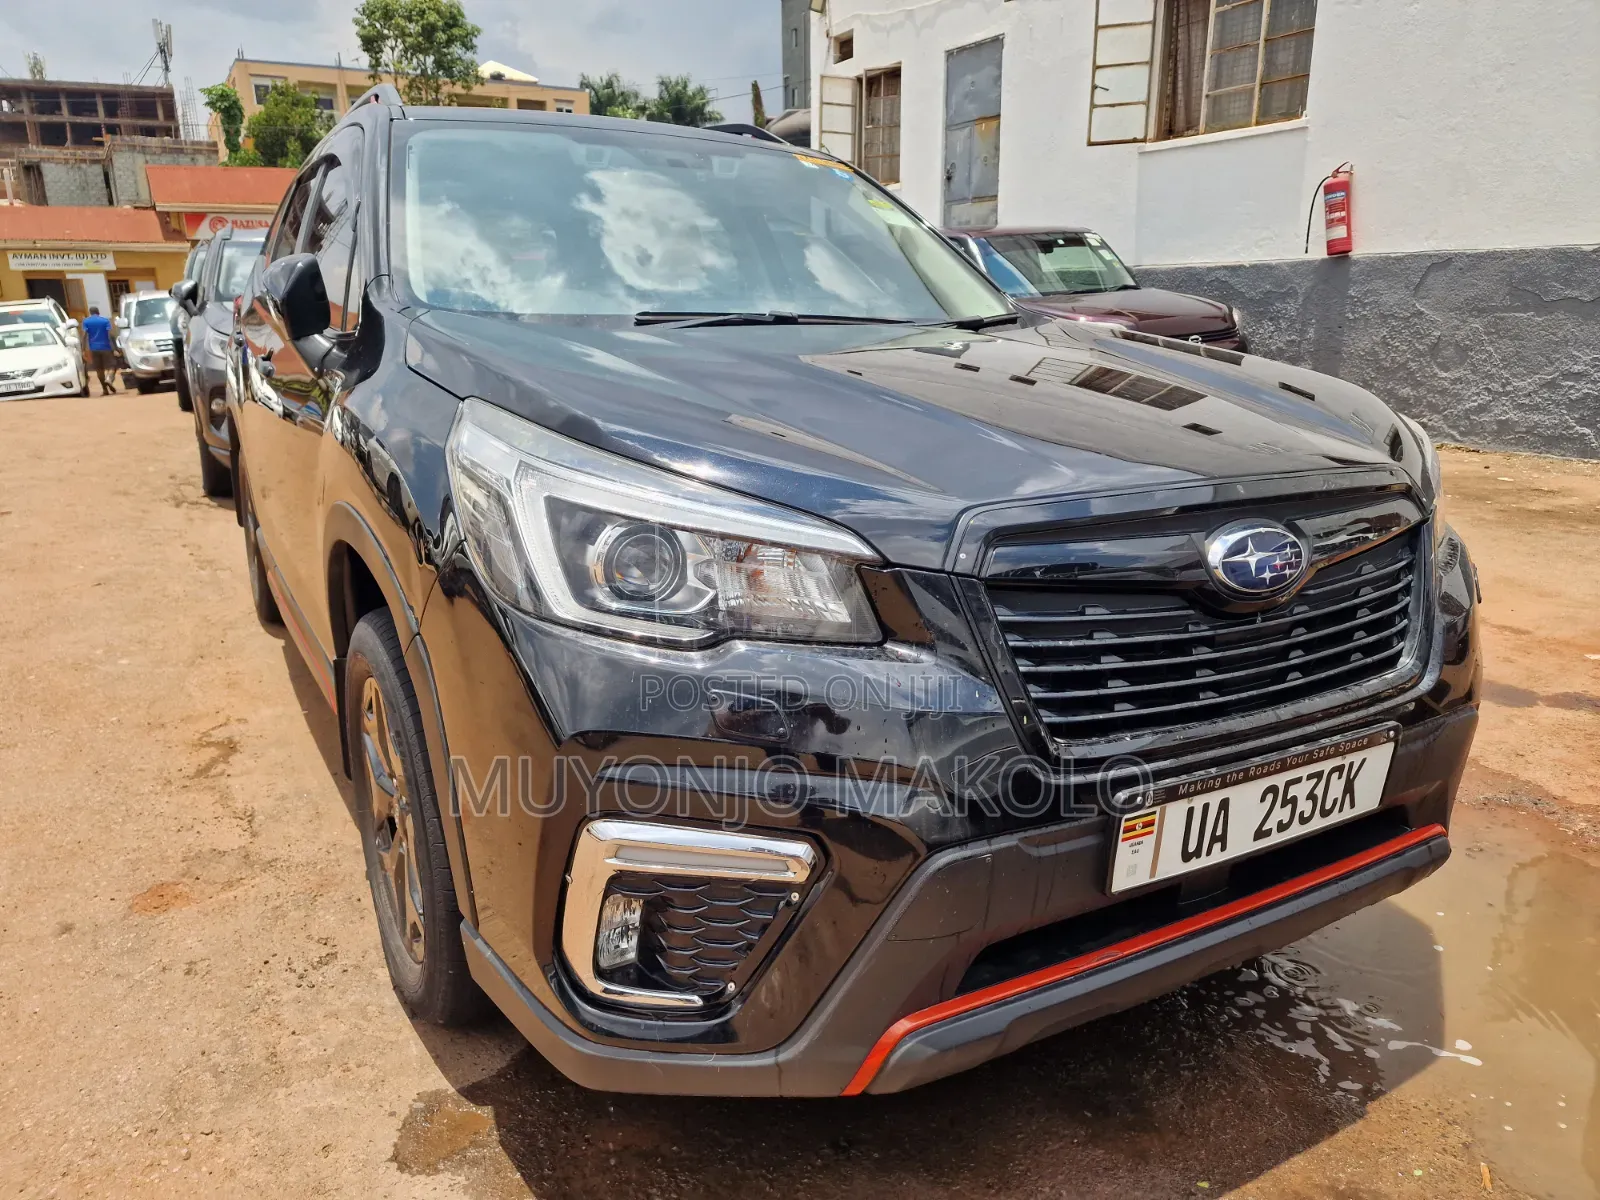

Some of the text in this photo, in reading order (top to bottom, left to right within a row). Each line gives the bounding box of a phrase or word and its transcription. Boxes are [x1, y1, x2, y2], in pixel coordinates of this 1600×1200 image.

[12, 252, 107, 261] AYMAN INVT. (U) LTD
[1178, 776, 1222, 796] Making
[1226, 771, 1244, 784] the
[1248, 760, 1281, 777] Roads
[1286, 753, 1309, 767] Your
[1312, 744, 1335, 760] Safe
[1339, 737, 1369, 753] Space
[1181, 757, 1368, 864] UA 253CK
